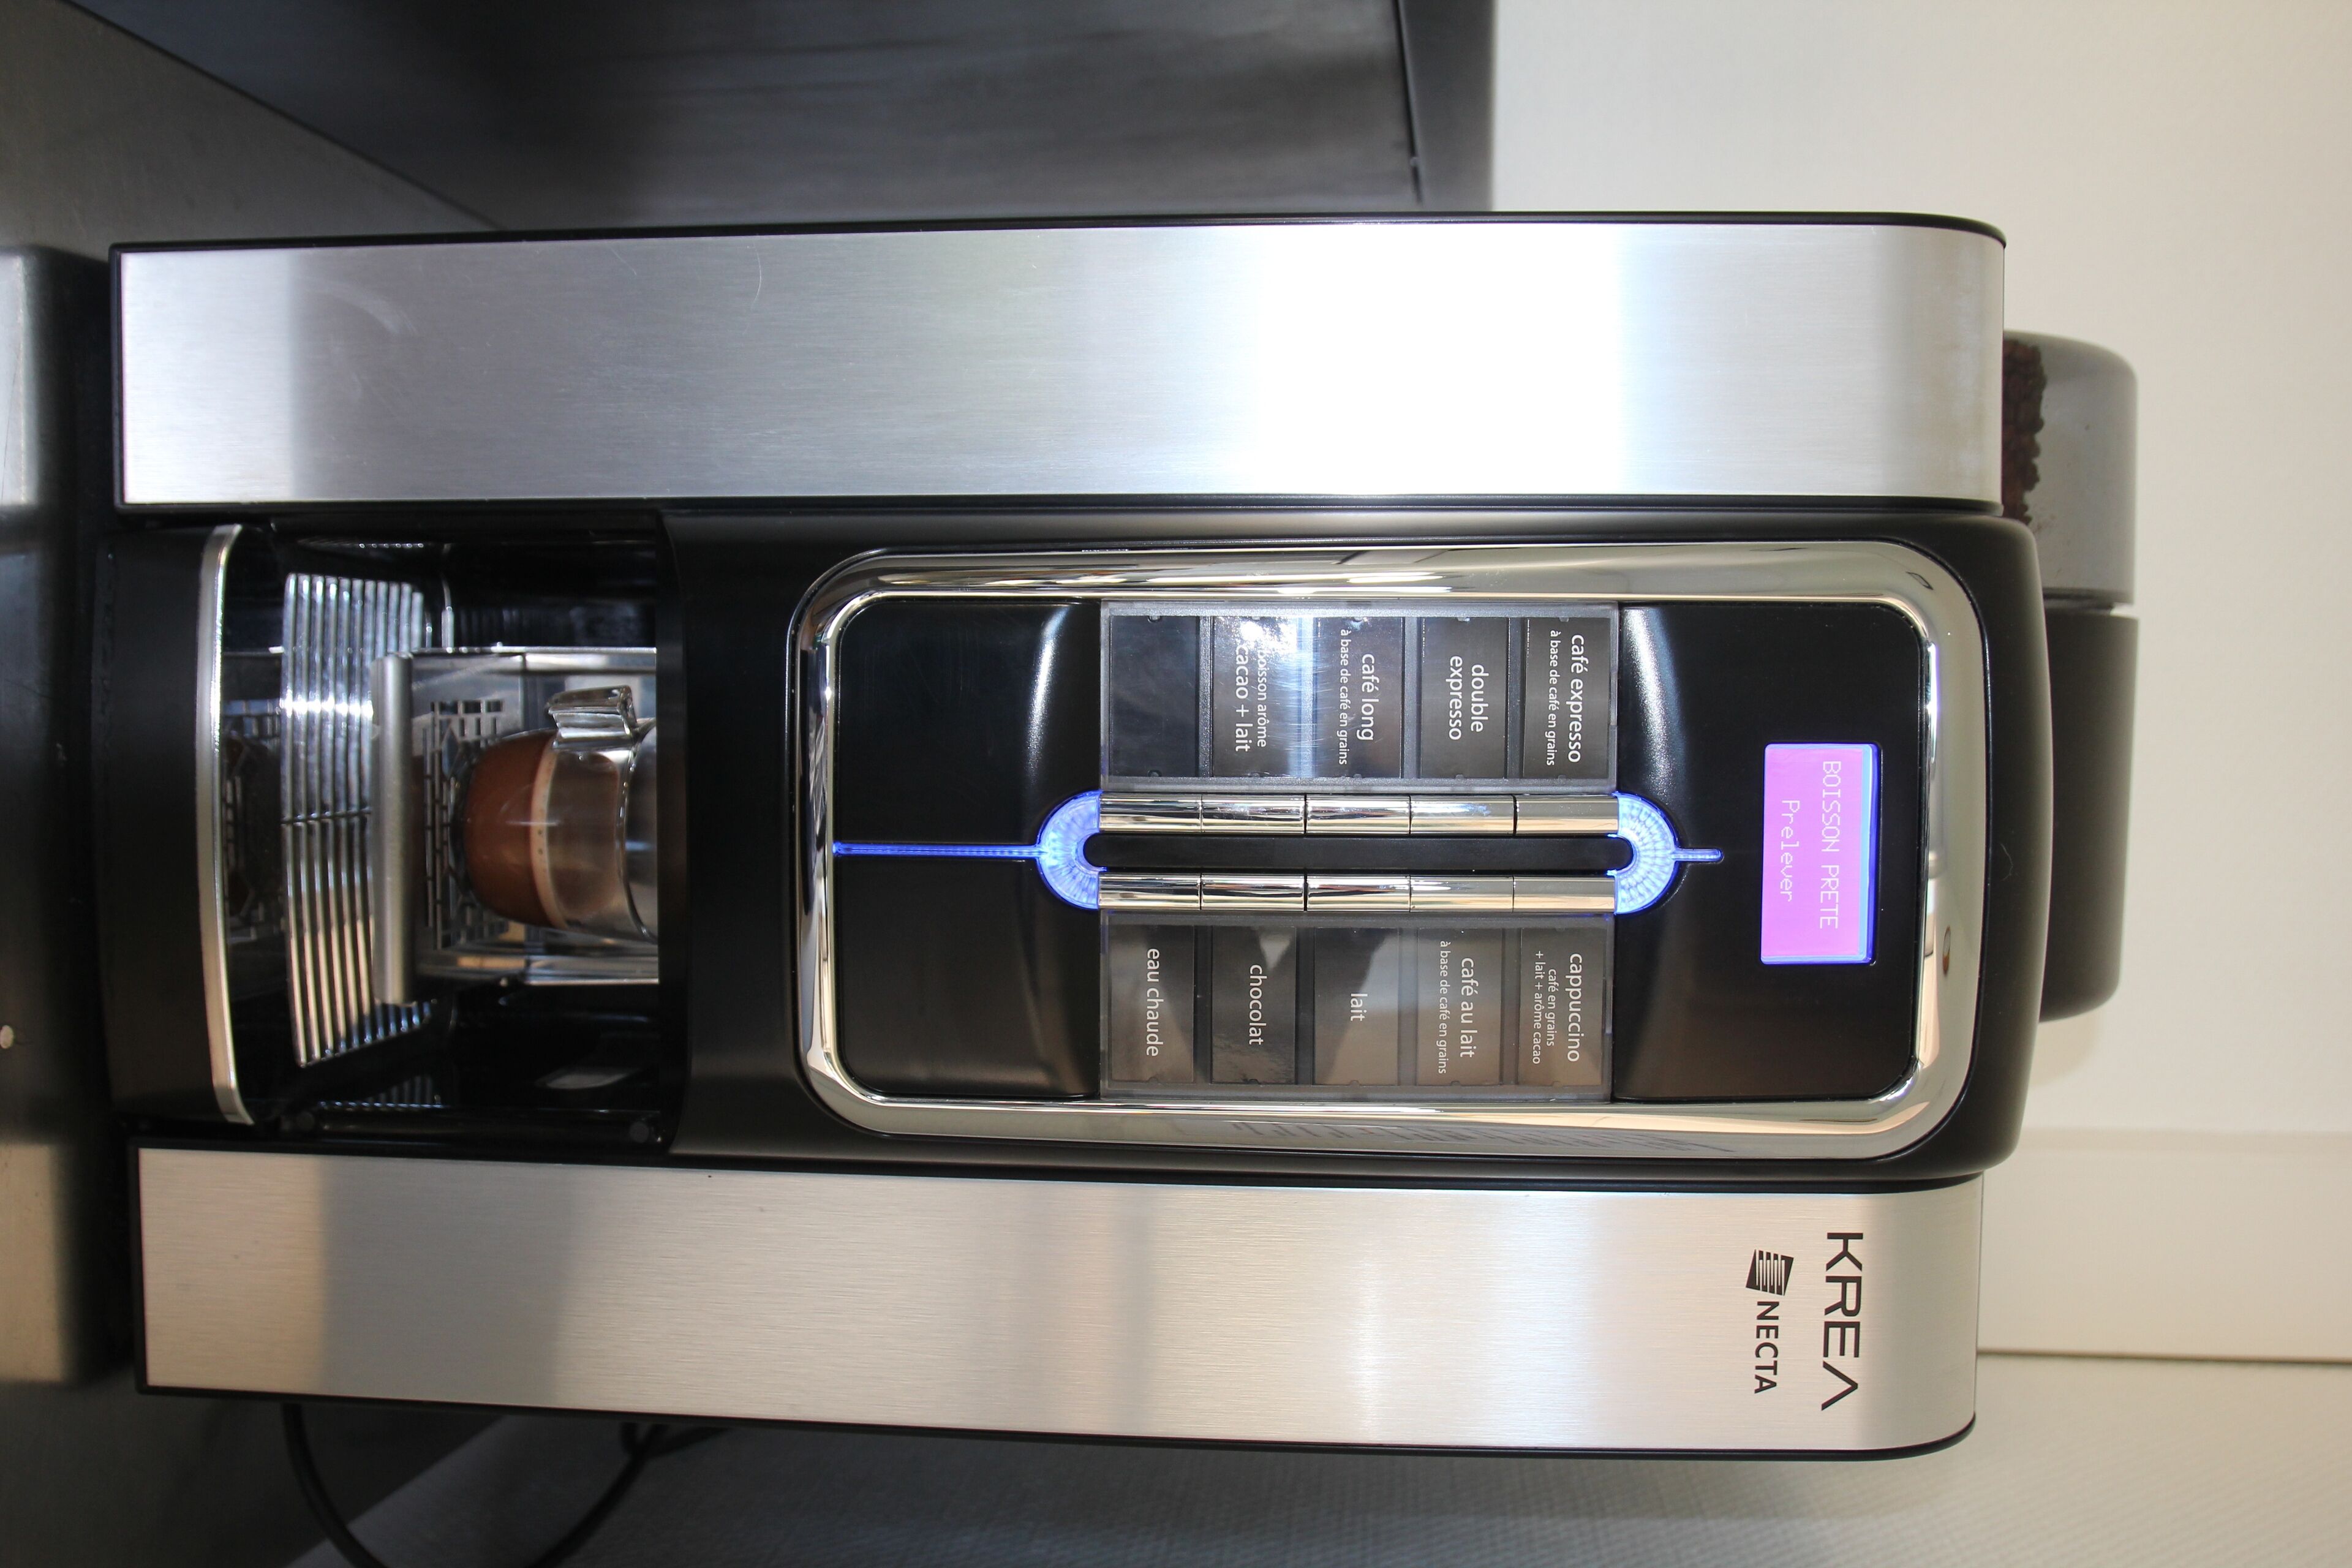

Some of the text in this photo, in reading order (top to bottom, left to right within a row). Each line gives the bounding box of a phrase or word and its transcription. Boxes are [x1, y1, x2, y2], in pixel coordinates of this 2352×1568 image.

[1340, 639, 1352, 666] base
[1550, 640, 1561, 667] base
[1340, 670, 1351, 684] de
[1549, 671, 1561, 685] de
[1235, 644, 1253, 752] cacao + lait
[1257, 650, 1270, 747] boisson arôme
[1340, 686, 1351, 710] café
[1357, 654, 1379, 741] café long
[1446, 655, 1463, 740] expresso
[1470, 664, 1489, 733] double
[1548, 687, 1560, 711] café
[1566, 635, 1589, 763] café expresso
[1340, 712, 1348, 727] en
[1548, 713, 1556, 728] en
[1336, 730, 1350, 765] grains
[1545, 731, 1558, 766] grains
[1780, 800, 1800, 902] Prelever
[1820, 761, 1841, 929] BOISSON PRETE
[1440, 951, 1451, 977] base
[1535, 962, 1546, 979] lait
[1146, 948, 1164, 1057] eau chaude
[1439, 980, 1450, 994] de
[1249, 965, 1267, 1045] chocolat
[1350, 993, 1368, 1022] lait
[1439, 997, 1450, 1020] café
[1460, 958, 1479, 1058] café au lait
[1534, 993, 1545, 1029] arôme
[1545, 969, 1559, 1046] café en grains
[1565, 953, 1585, 1062] cappuccino
[1439, 1023, 1447, 1037] en
[1436, 1040, 1449, 1074] grains
[1532, 1031, 1541, 1065] cacao
[1754, 1301, 1780, 1394] NECTA
